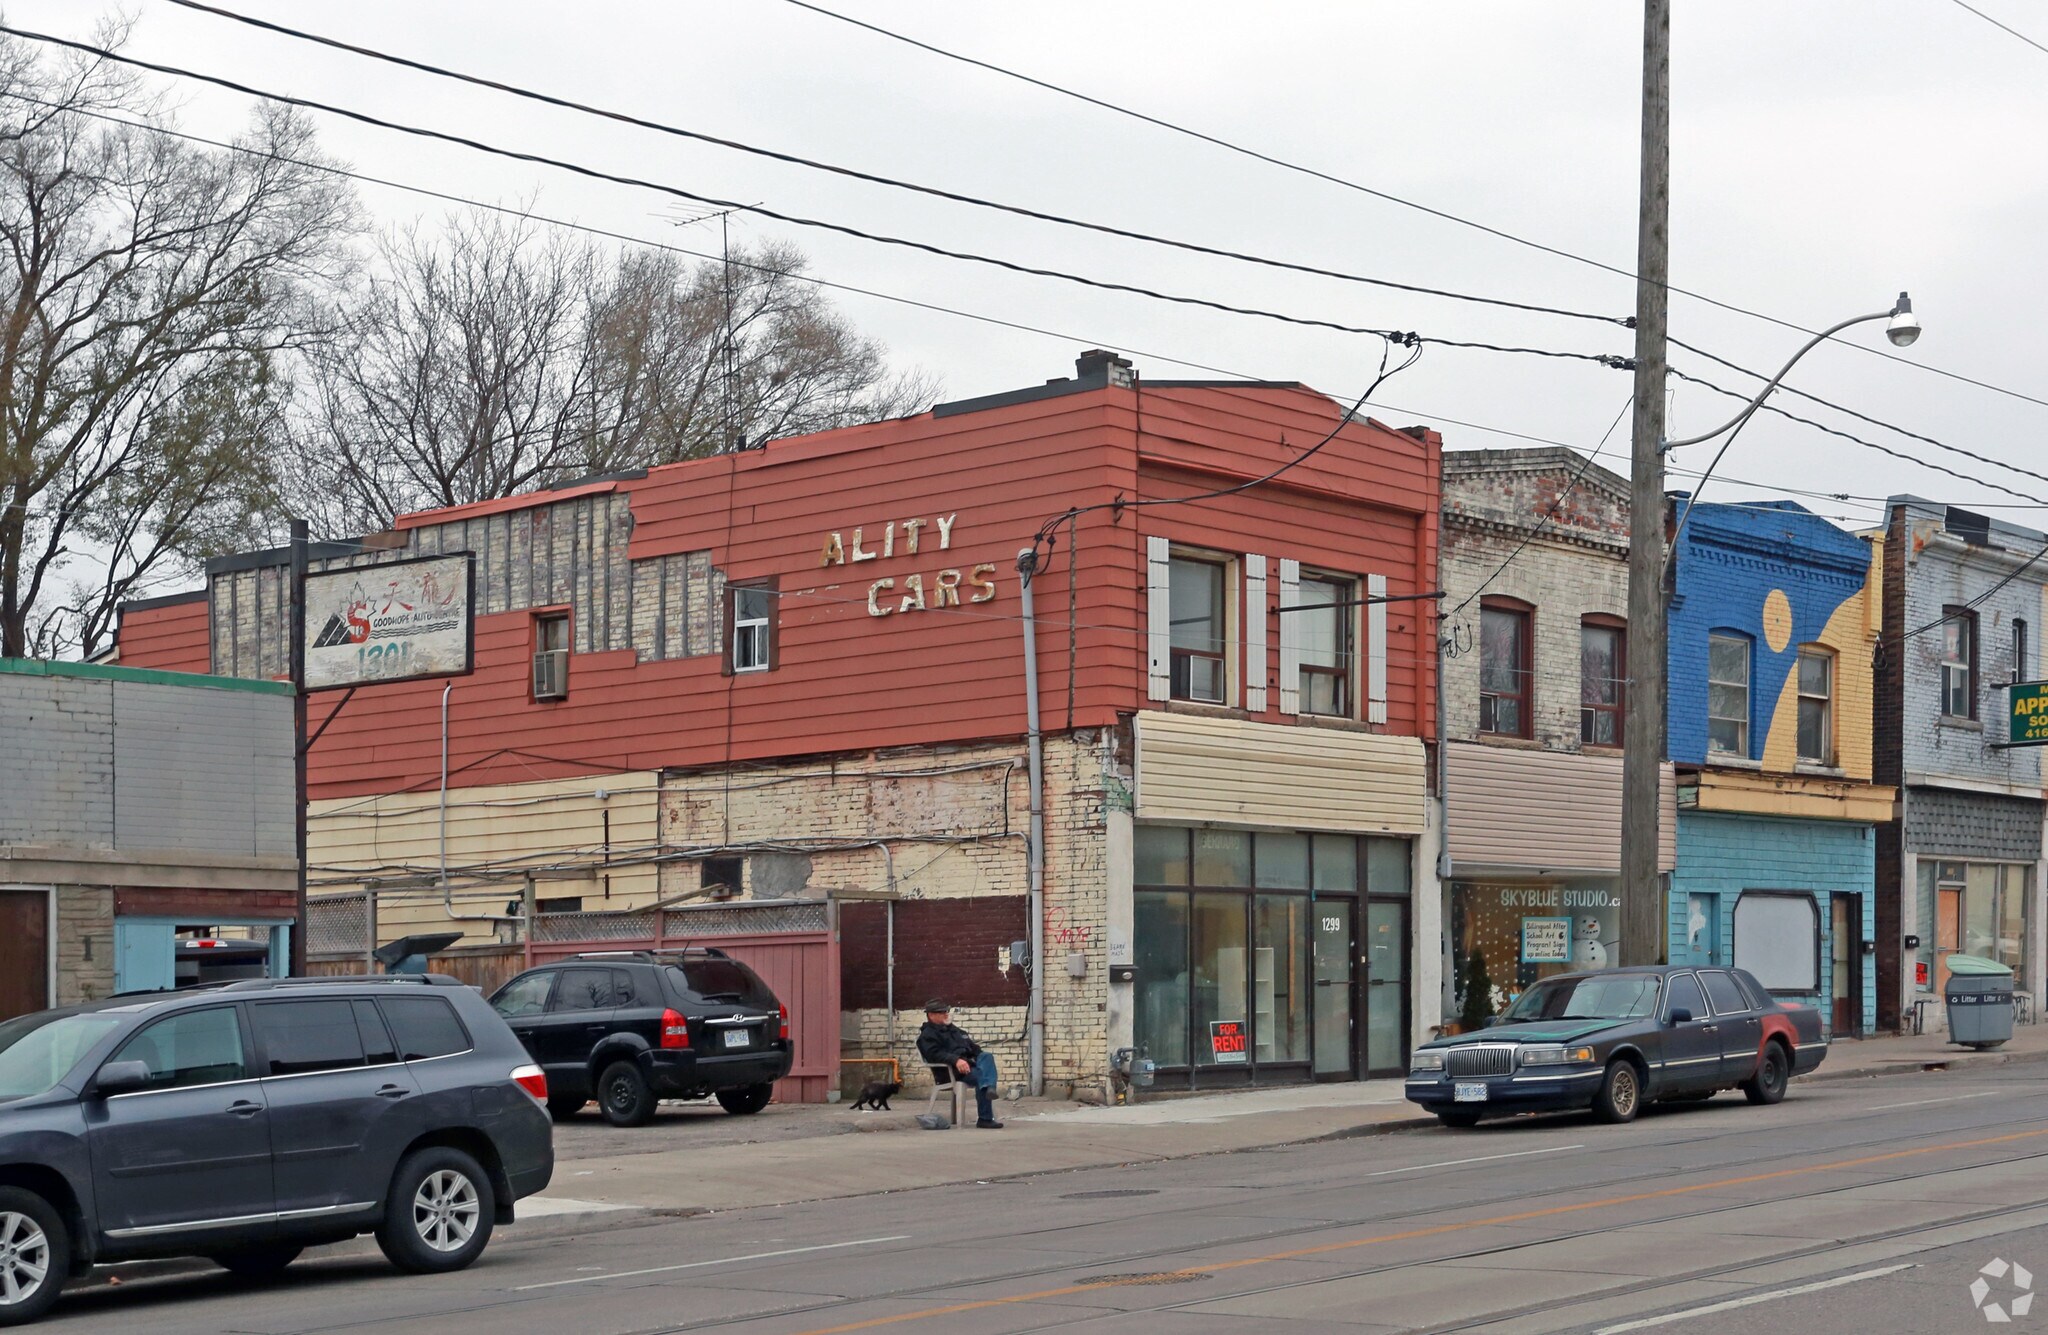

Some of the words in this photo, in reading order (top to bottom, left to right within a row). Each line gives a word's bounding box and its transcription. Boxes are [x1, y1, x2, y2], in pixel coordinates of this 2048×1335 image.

[820, 511, 958, 567] ALITY
[867, 562, 996, 617] CARS
[1500, 889, 1558, 907] SKYBLUE
[1322, 917, 1340, 932] 1299
[1526, 931, 1543, 939] School
[1545, 931, 1555, 939] Art
[1553, 940, 1566, 951] Sign
[1961, 995, 1978, 1003] Litter
[1219, 1023, 1238, 1036] FOR
[1213, 1035, 1246, 1052] RENT
